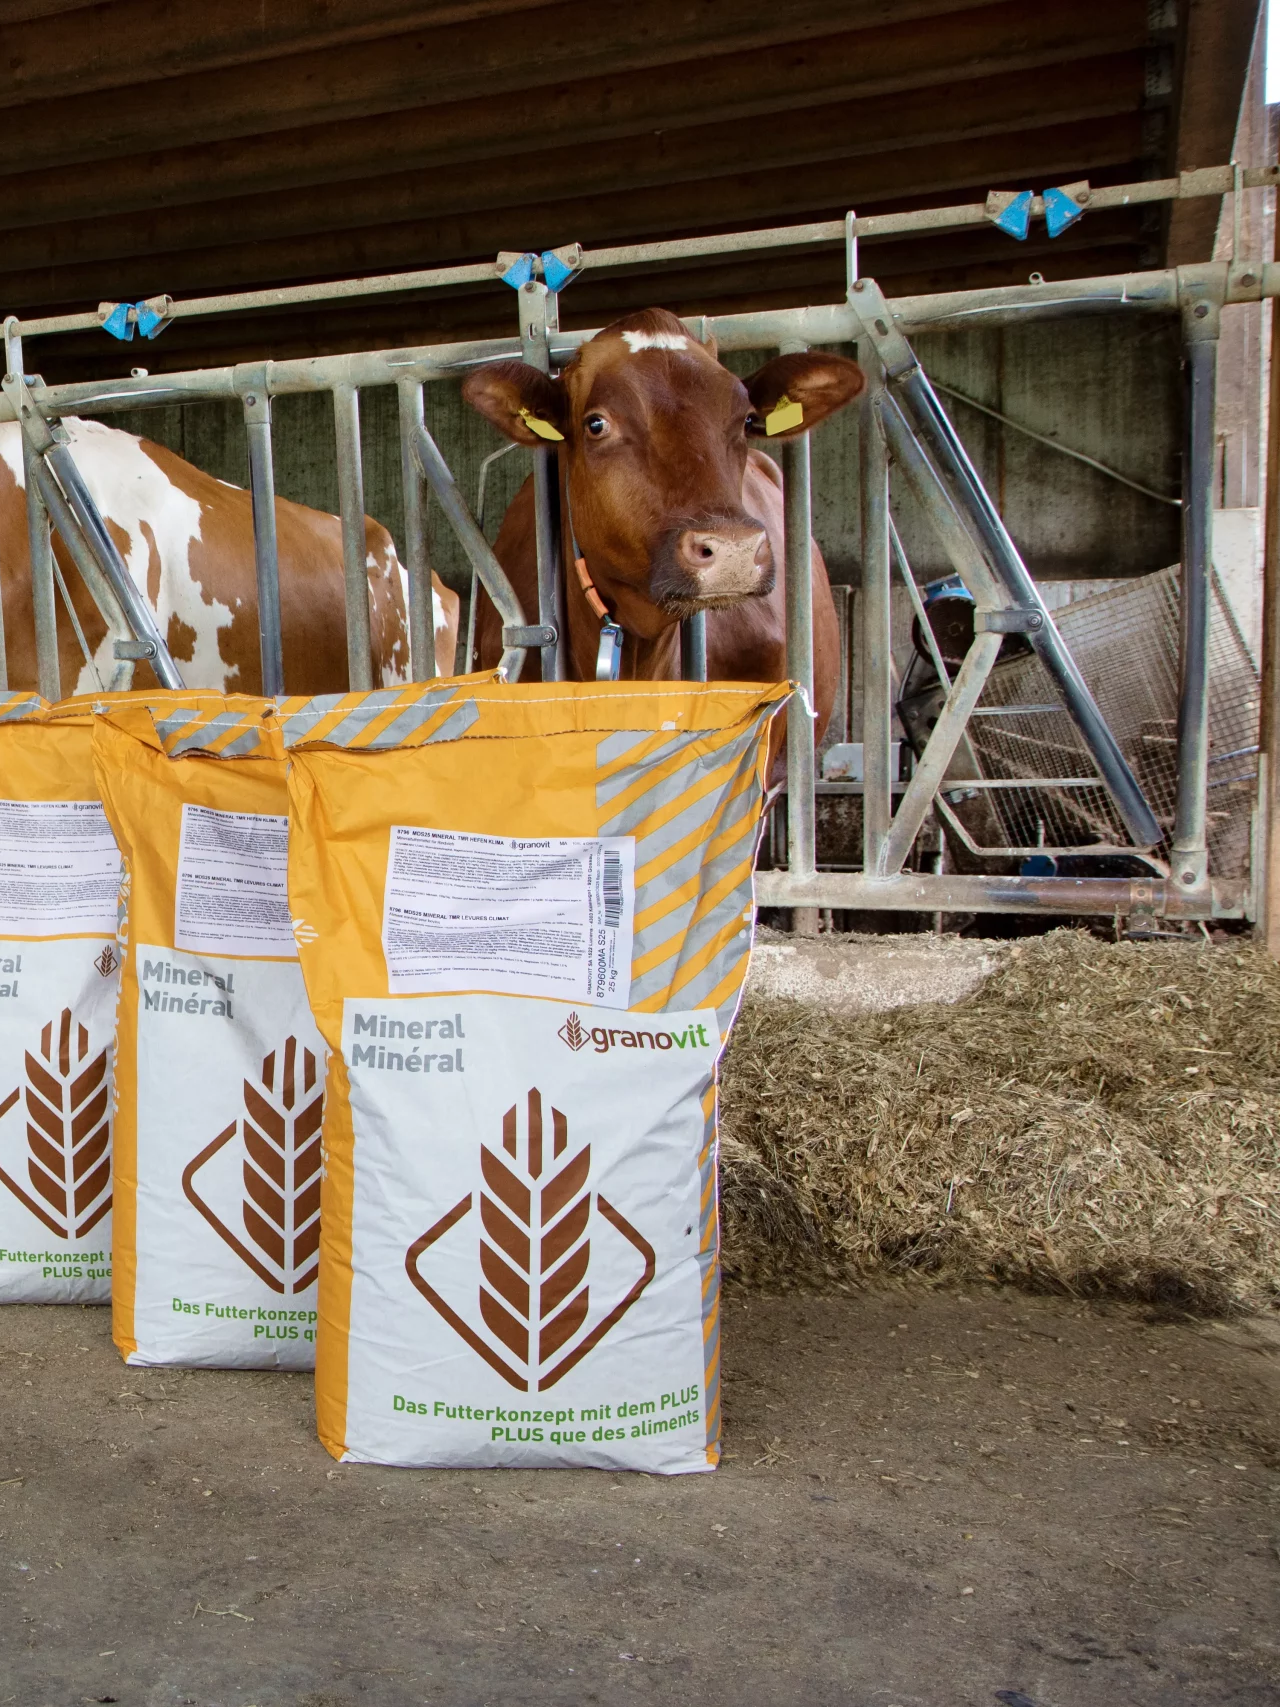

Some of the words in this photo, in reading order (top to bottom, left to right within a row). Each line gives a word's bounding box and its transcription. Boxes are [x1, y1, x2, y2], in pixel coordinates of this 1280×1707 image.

[79, 803, 104, 811] granovit
[214, 811, 235, 820] MINERAL
[431, 833, 456, 841] MINERAL
[469, 836, 488, 844] HEFEN
[518, 841, 551, 850] granovit
[422, 912, 448, 920] MINERAL
[598, 929, 606, 946] S25
[587, 959, 593, 967] SA
[143, 959, 235, 994] Mineral
[596, 948, 607, 998] 879600MA
[609, 969, 618, 981] kg
[608, 982, 615, 993] 25
[144, 989, 234, 1019] Minéral
[353, 1013, 465, 1040] Mineral
[591, 1023, 710, 1053] granovit
[351, 1043, 465, 1073] Minéral
[0, 1249, 104, 1265] Futterkonzept
[42, 1266, 82, 1278] PLUS
[87, 1268, 112, 1280] que
[172, 1297, 200, 1315] Das
[205, 1302, 318, 1325] Futterkonzep
[253, 1325, 299, 1339] PLUS
[393, 1394, 428, 1415] Das
[434, 1401, 575, 1425] Futterkonzept
[580, 1404, 612, 1422] mit
[617, 1400, 656, 1418] dem
[660, 1384, 699, 1411] PLUS
[491, 1426, 544, 1442] PLUS
[550, 1430, 586, 1445] que
[591, 1425, 626, 1442] des
[630, 1409, 700, 1438] aliments
